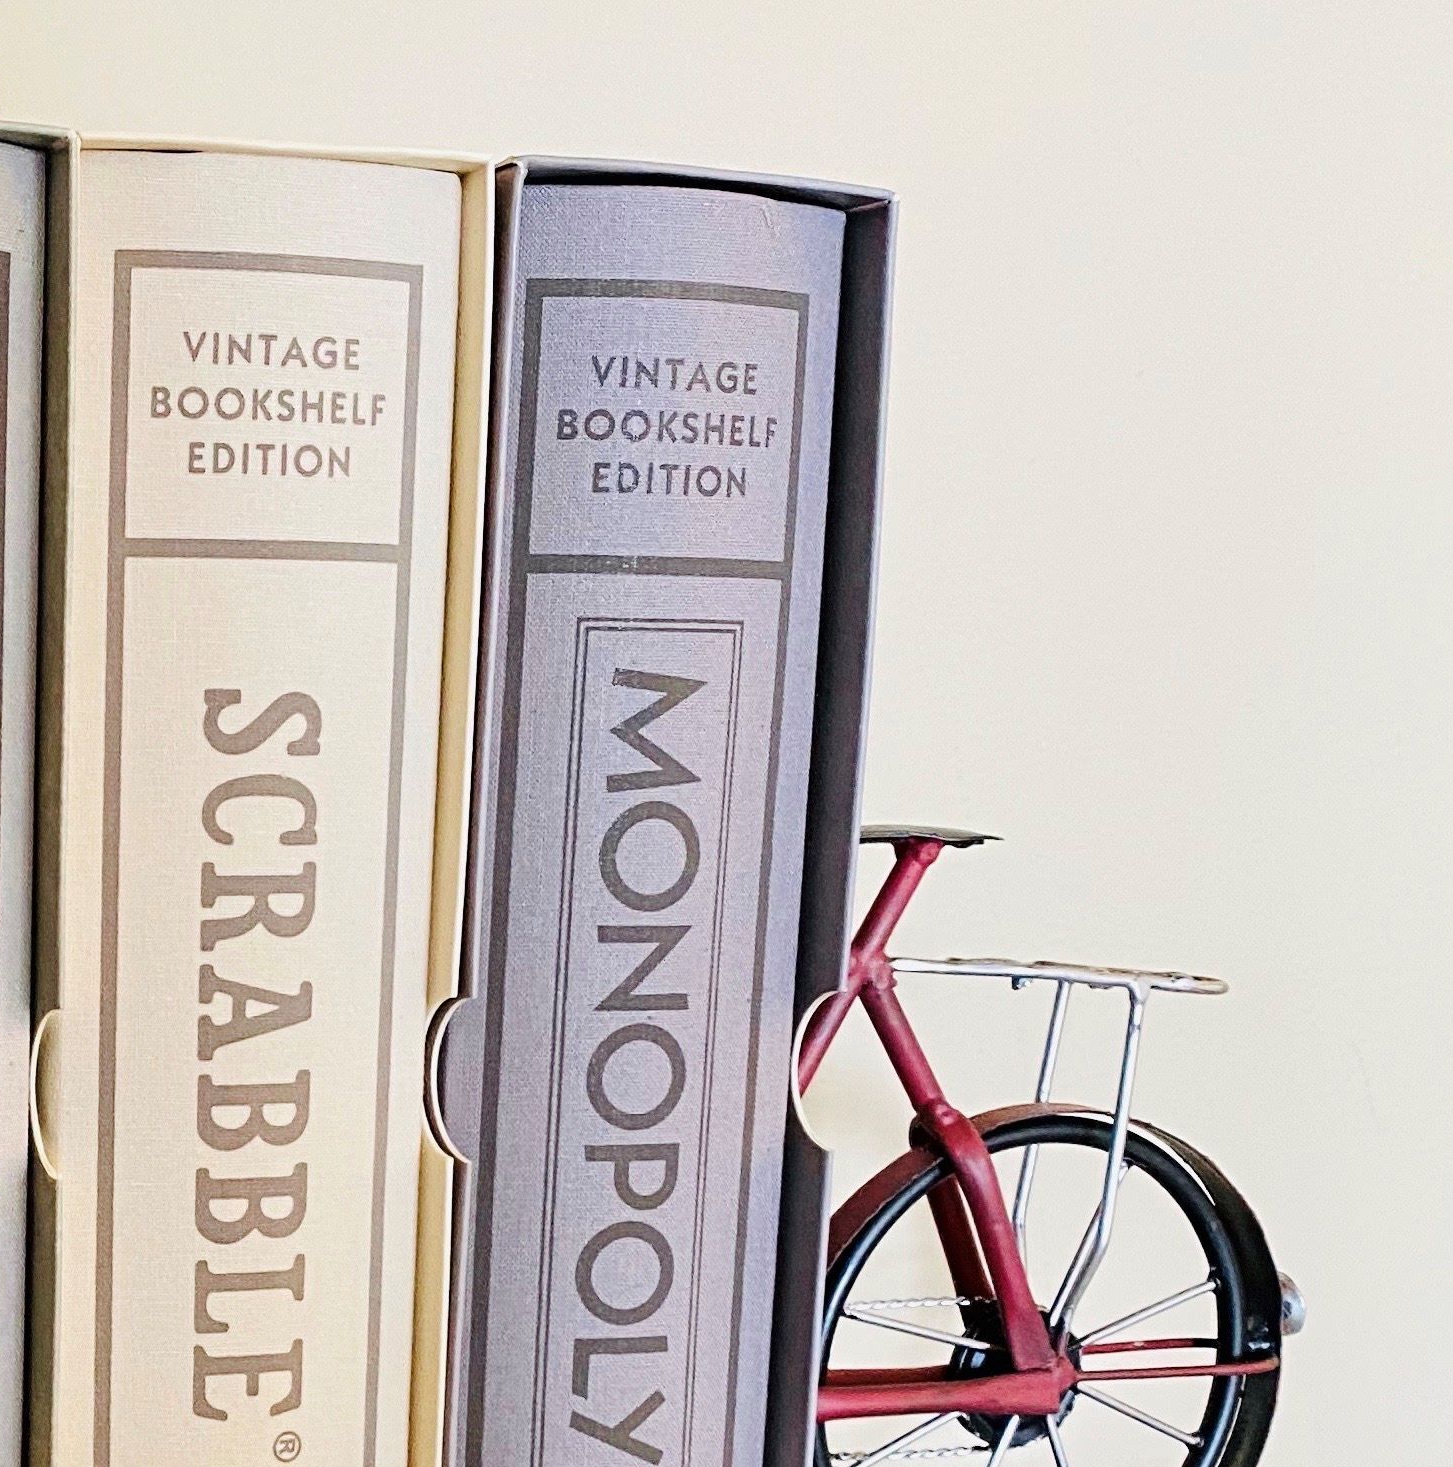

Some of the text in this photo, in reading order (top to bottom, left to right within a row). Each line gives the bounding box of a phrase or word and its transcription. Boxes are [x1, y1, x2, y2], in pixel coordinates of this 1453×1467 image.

[182, 330, 361, 372] VINTAGE
[590, 354, 759, 396] VINTAGE
[150, 386, 387, 427] BOOKSHELF
[555, 407, 779, 448] BOOKSHELF
[187, 441, 351, 478] EDITION
[590, 462, 748, 498] EDITION
[569, 667, 708, 1466] MONOPOLY
